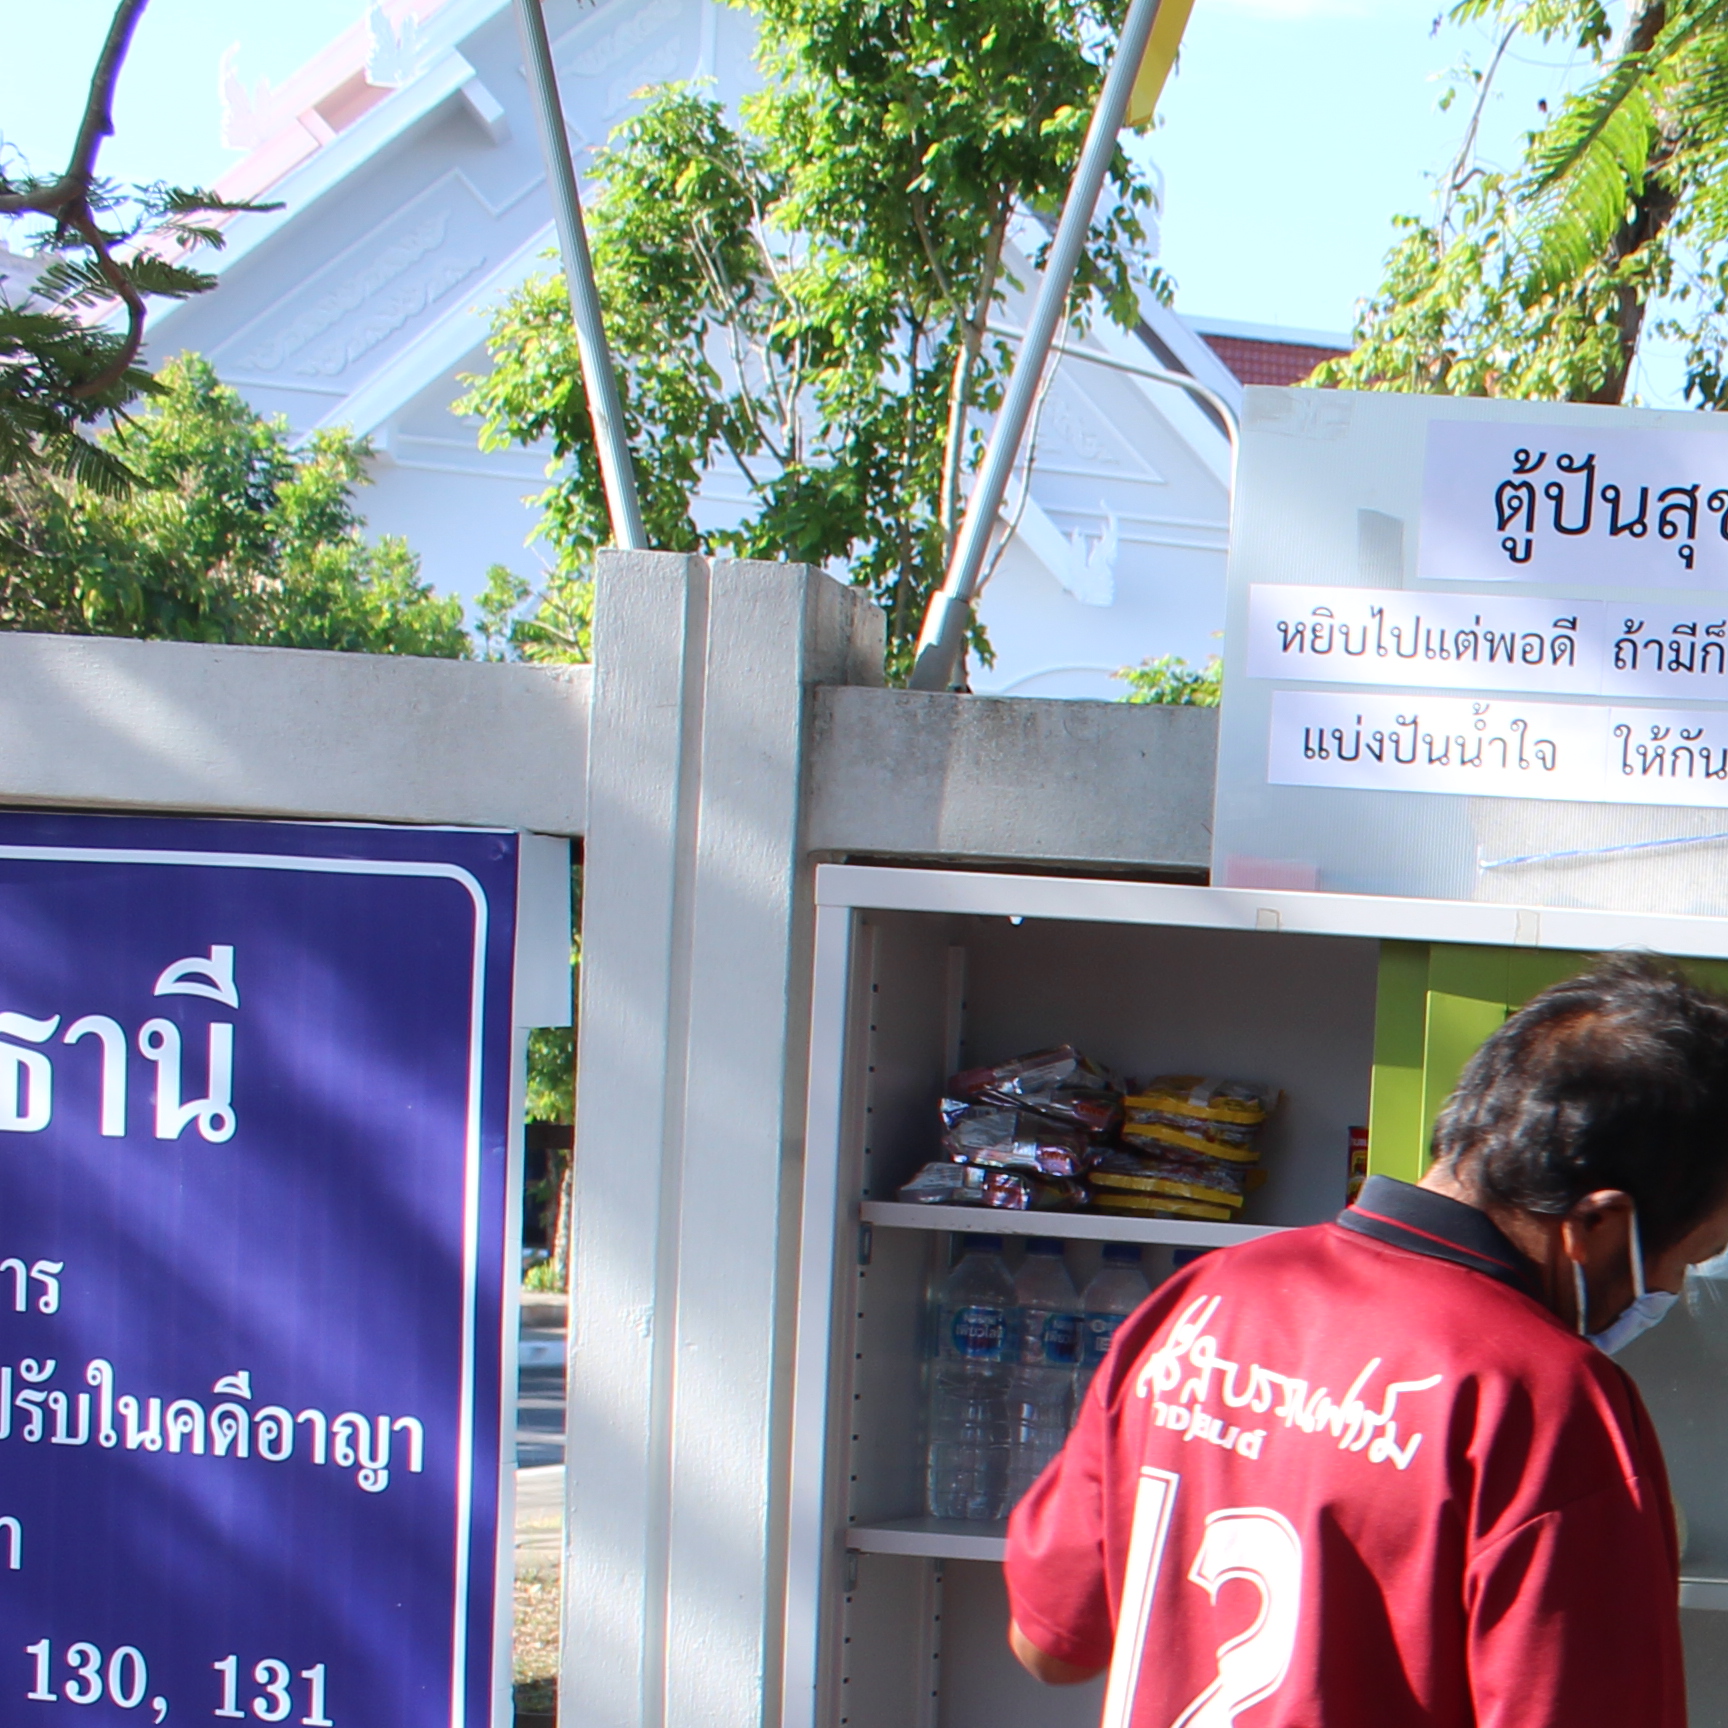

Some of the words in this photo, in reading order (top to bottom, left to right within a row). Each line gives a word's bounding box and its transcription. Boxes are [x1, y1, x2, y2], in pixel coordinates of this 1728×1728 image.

[1275, 605, 1579, 670] หยิบไปแต่พอดี
[1301, 702, 1559, 774] แบ่งปันน้ำใจ
[25, 1637, 169, 1725] 130,
[212, 1653, 335, 1728] 131
